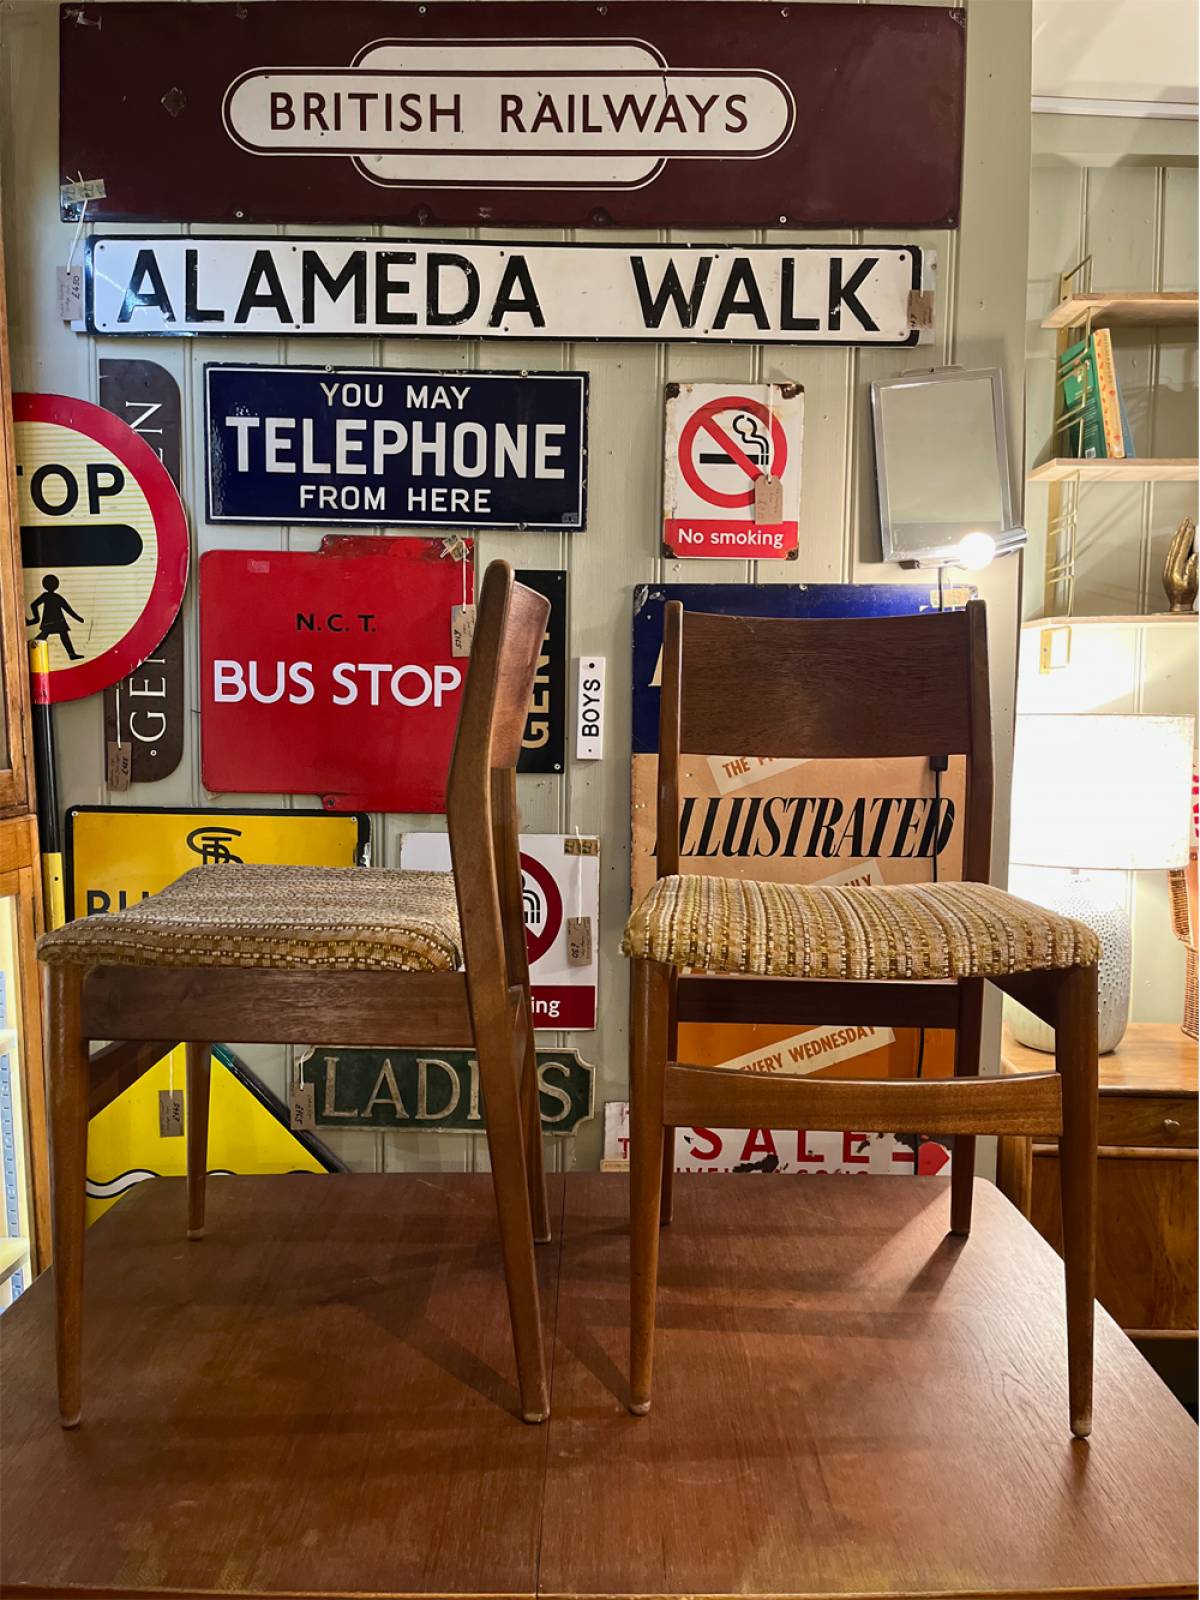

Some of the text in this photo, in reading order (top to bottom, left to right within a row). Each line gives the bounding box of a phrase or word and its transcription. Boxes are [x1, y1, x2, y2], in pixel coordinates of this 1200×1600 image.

[270, 92, 749, 134] BRITISH RAILWAYS
[117, 249, 547, 328] ALAMEDA
[629, 255, 880, 332] WALK
[320, 382, 471, 410] YOU MAY
[225, 416, 566, 480] TELEPHONE
[17, 463, 126, 517] OP
[299, 484, 492, 514] FROM HERE
[677, 527, 785, 550] No smoking
[213, 659, 315, 704] BUS
[332, 662, 462, 707] STOP
[581, 678, 601, 738] BOYS
[722, 757, 751, 779] THE
[650, 796, 956, 859] LLUSTRATED
[788, 1025, 876, 1062] WEDNESDAY
[322, 1055, 573, 1123] LADIS
